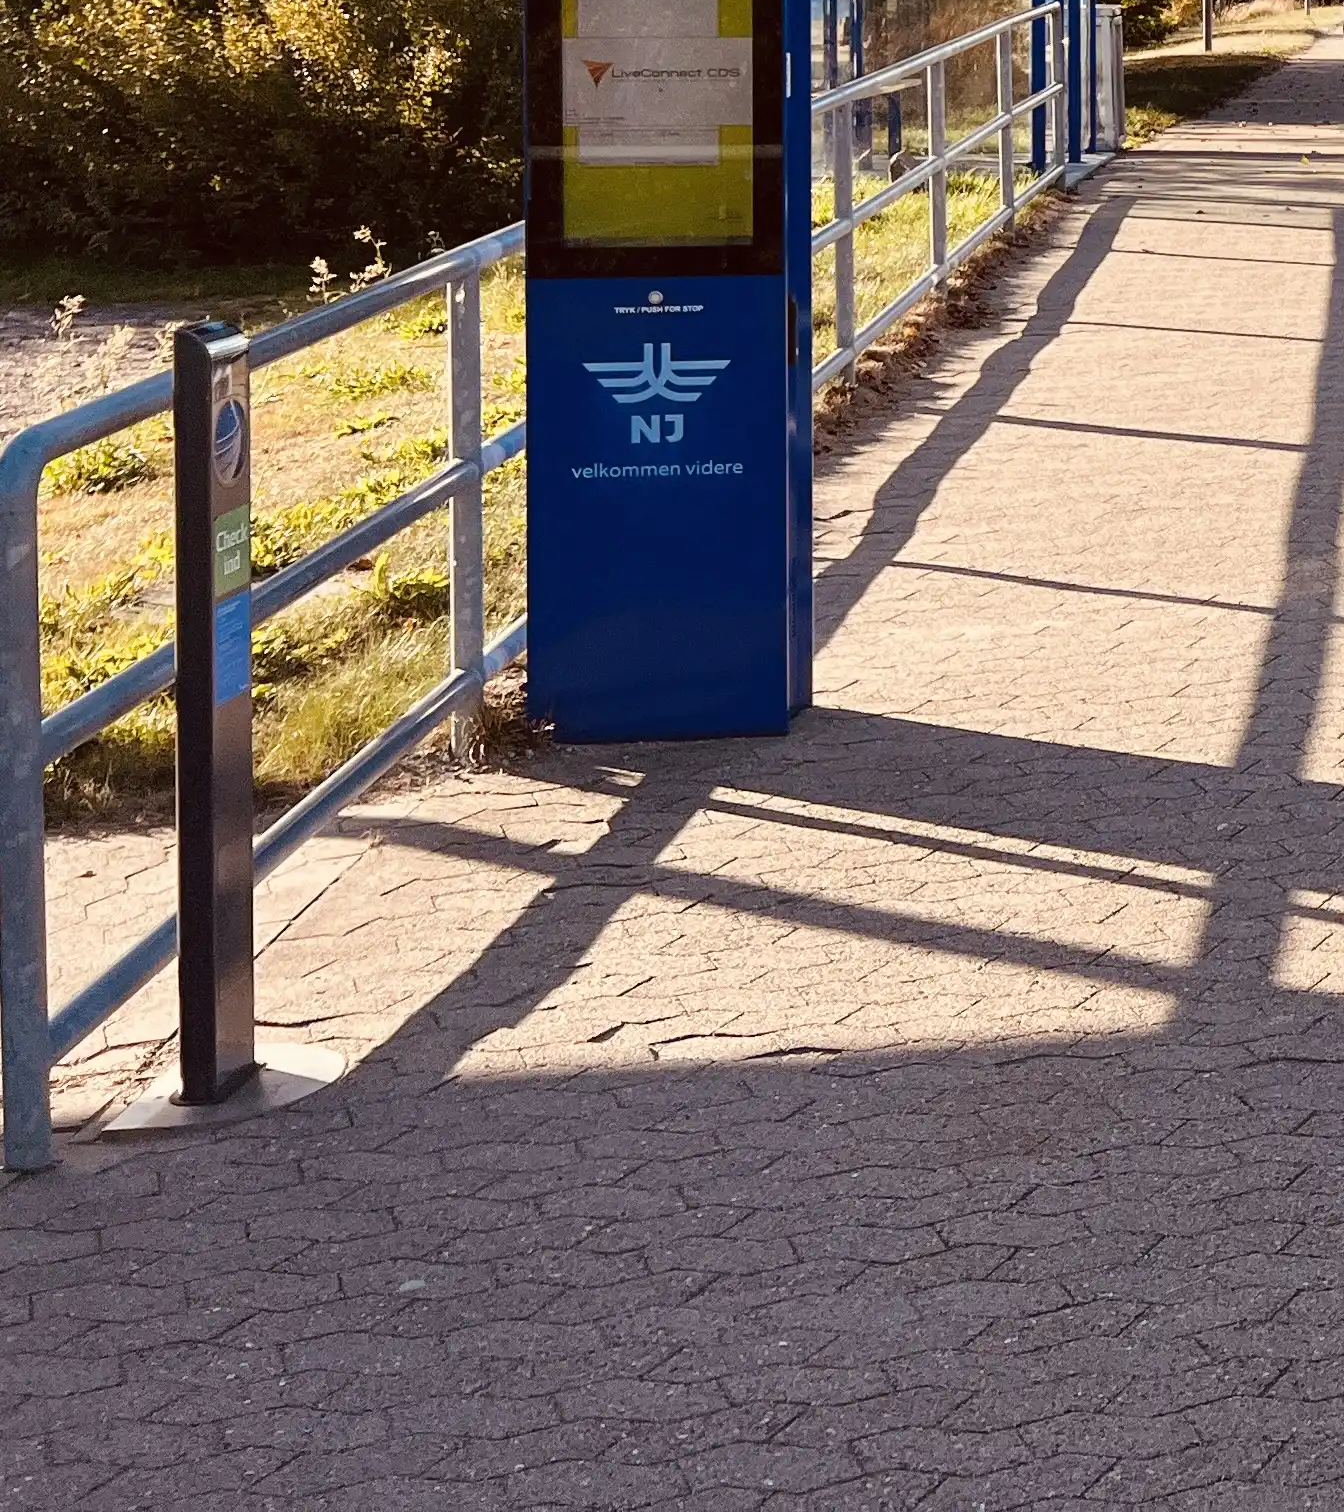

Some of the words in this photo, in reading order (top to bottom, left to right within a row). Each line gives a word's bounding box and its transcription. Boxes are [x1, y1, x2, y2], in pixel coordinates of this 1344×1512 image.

[706, 68, 741, 78] CDS
[664, 305, 681, 313] FOR
[682, 304, 704, 313] STOP
[630, 414, 684, 444] NJ
[571, 462, 681, 479] velkommen
[685, 459, 744, 475] videre
[215, 521, 249, 553] Check
[223, 550, 241, 576] ind
